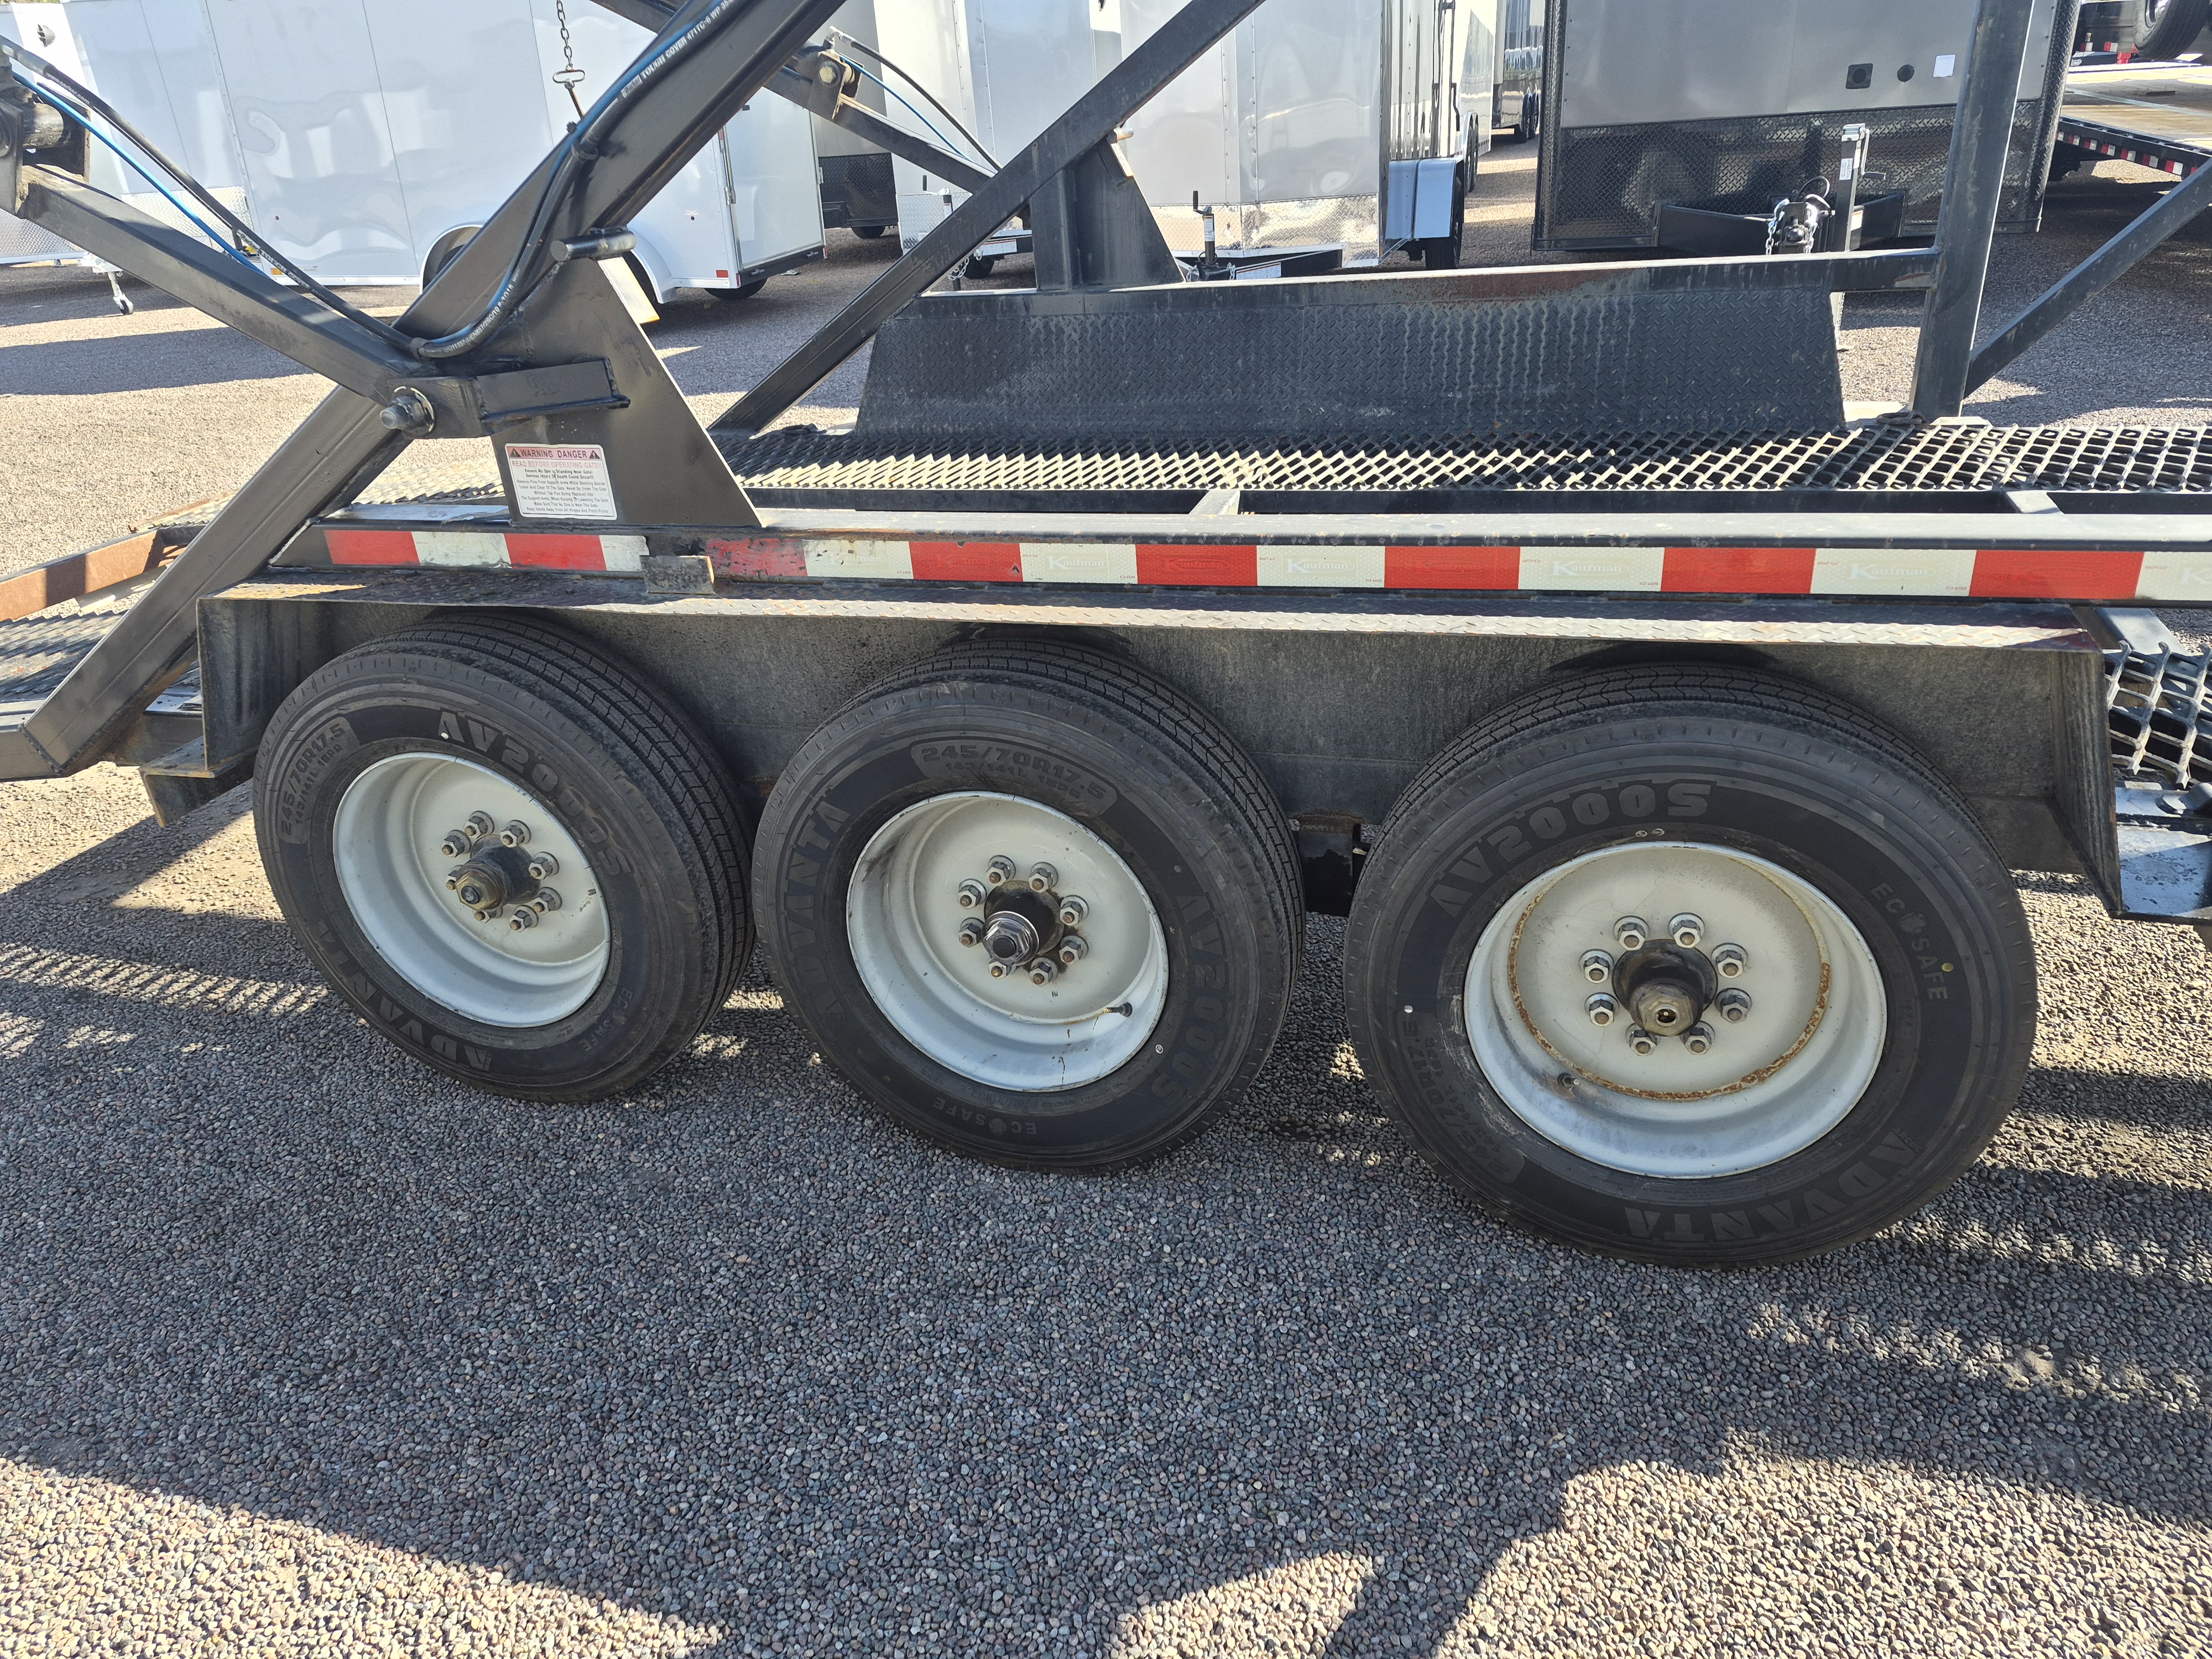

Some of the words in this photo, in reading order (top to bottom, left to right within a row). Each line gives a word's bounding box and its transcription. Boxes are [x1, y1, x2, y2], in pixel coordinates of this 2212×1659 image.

[520, 449, 554, 458] WARNING
[557, 450, 587, 458] DANGER
[1047, 556, 1104, 570] Kaufman
[1286, 559, 1349, 573] Kaufman
[1551, 561, 1622, 576] Kaufman
[1849, 564, 1928, 580] Kaufman
[281, 723, 346, 836] 245/70R17.5
[438, 711, 633, 876] AV2000S
[921, 744, 1107, 800] 245/70R17.5
[1430, 782, 1712, 919] AV2000S
[785, 800, 852, 1014] ADVANTA
[317, 920, 489, 1071] ADVANTA
[1151, 895, 1227, 1103] AV2000S
[1624, 1131, 1918, 1242] ADVANTA
